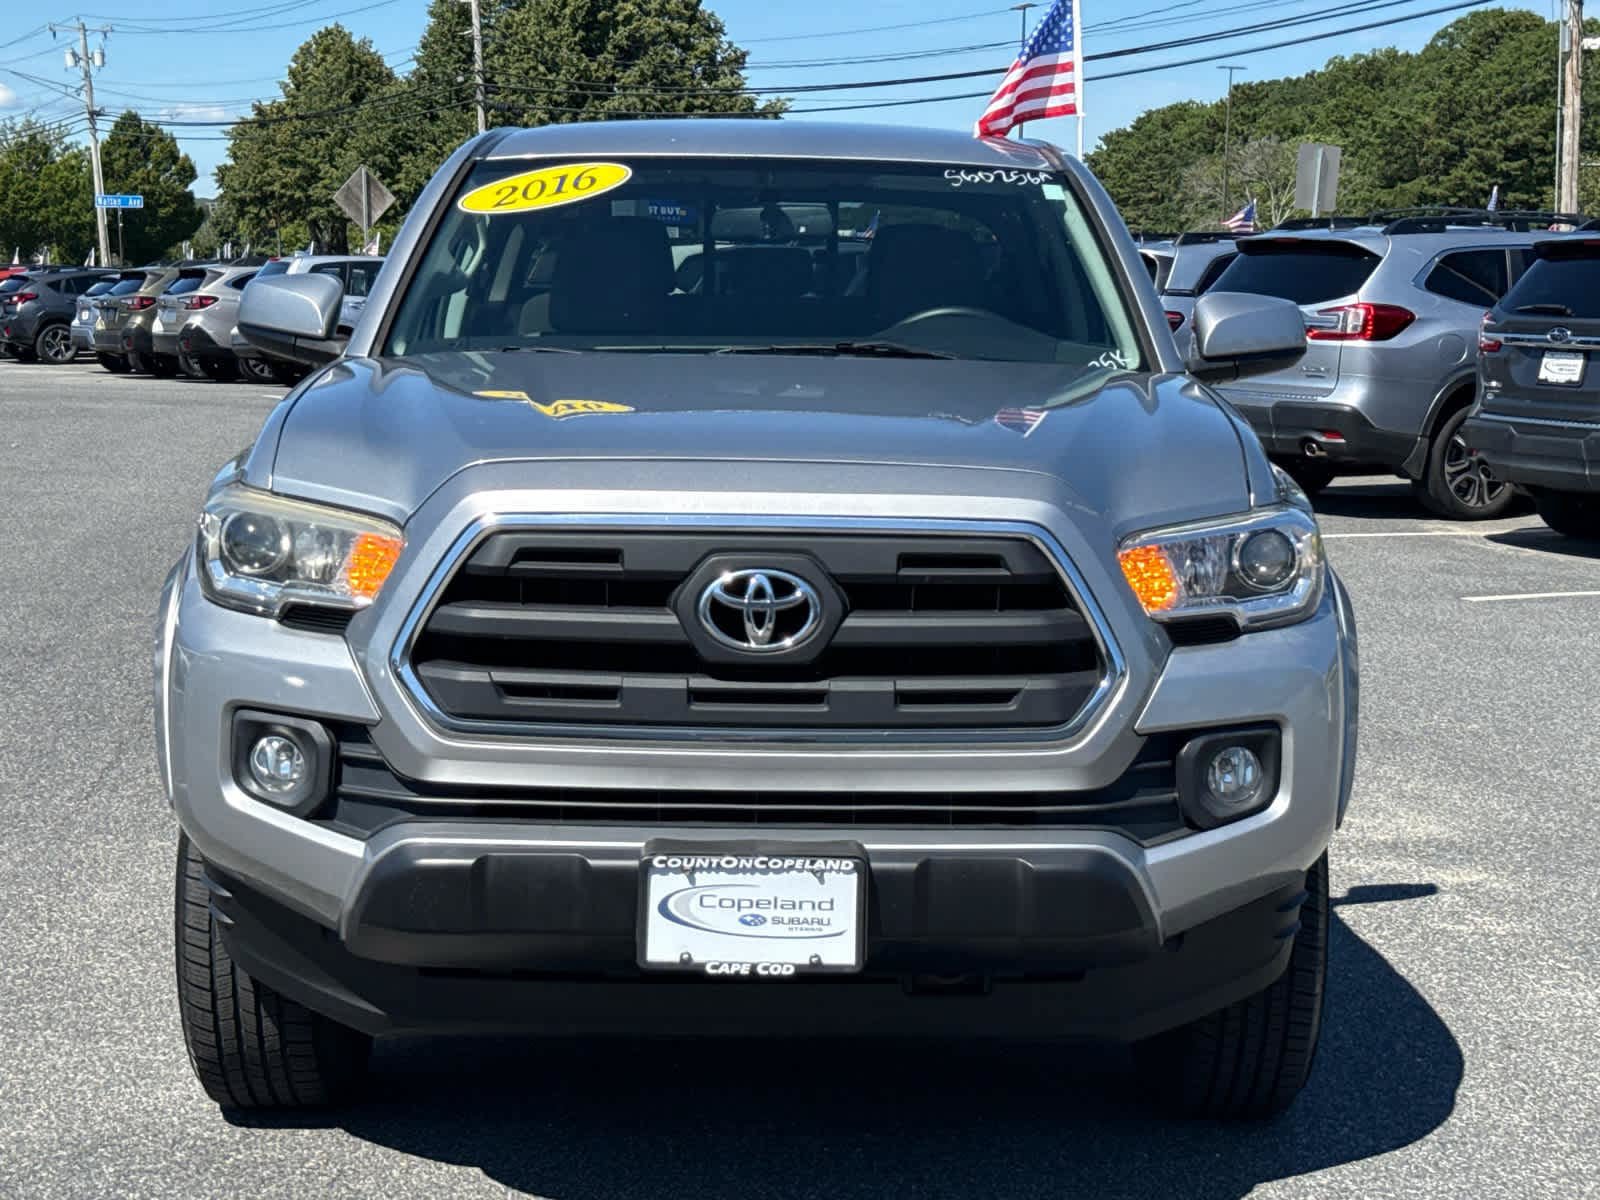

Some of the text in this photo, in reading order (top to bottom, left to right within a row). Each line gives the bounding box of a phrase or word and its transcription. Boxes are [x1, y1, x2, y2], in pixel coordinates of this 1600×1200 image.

[493, 167, 598, 208] 2016
[699, 894, 834, 912] Copeland
[771, 916, 831, 926] SUBARU
[704, 961, 796, 976] CAPE COD
